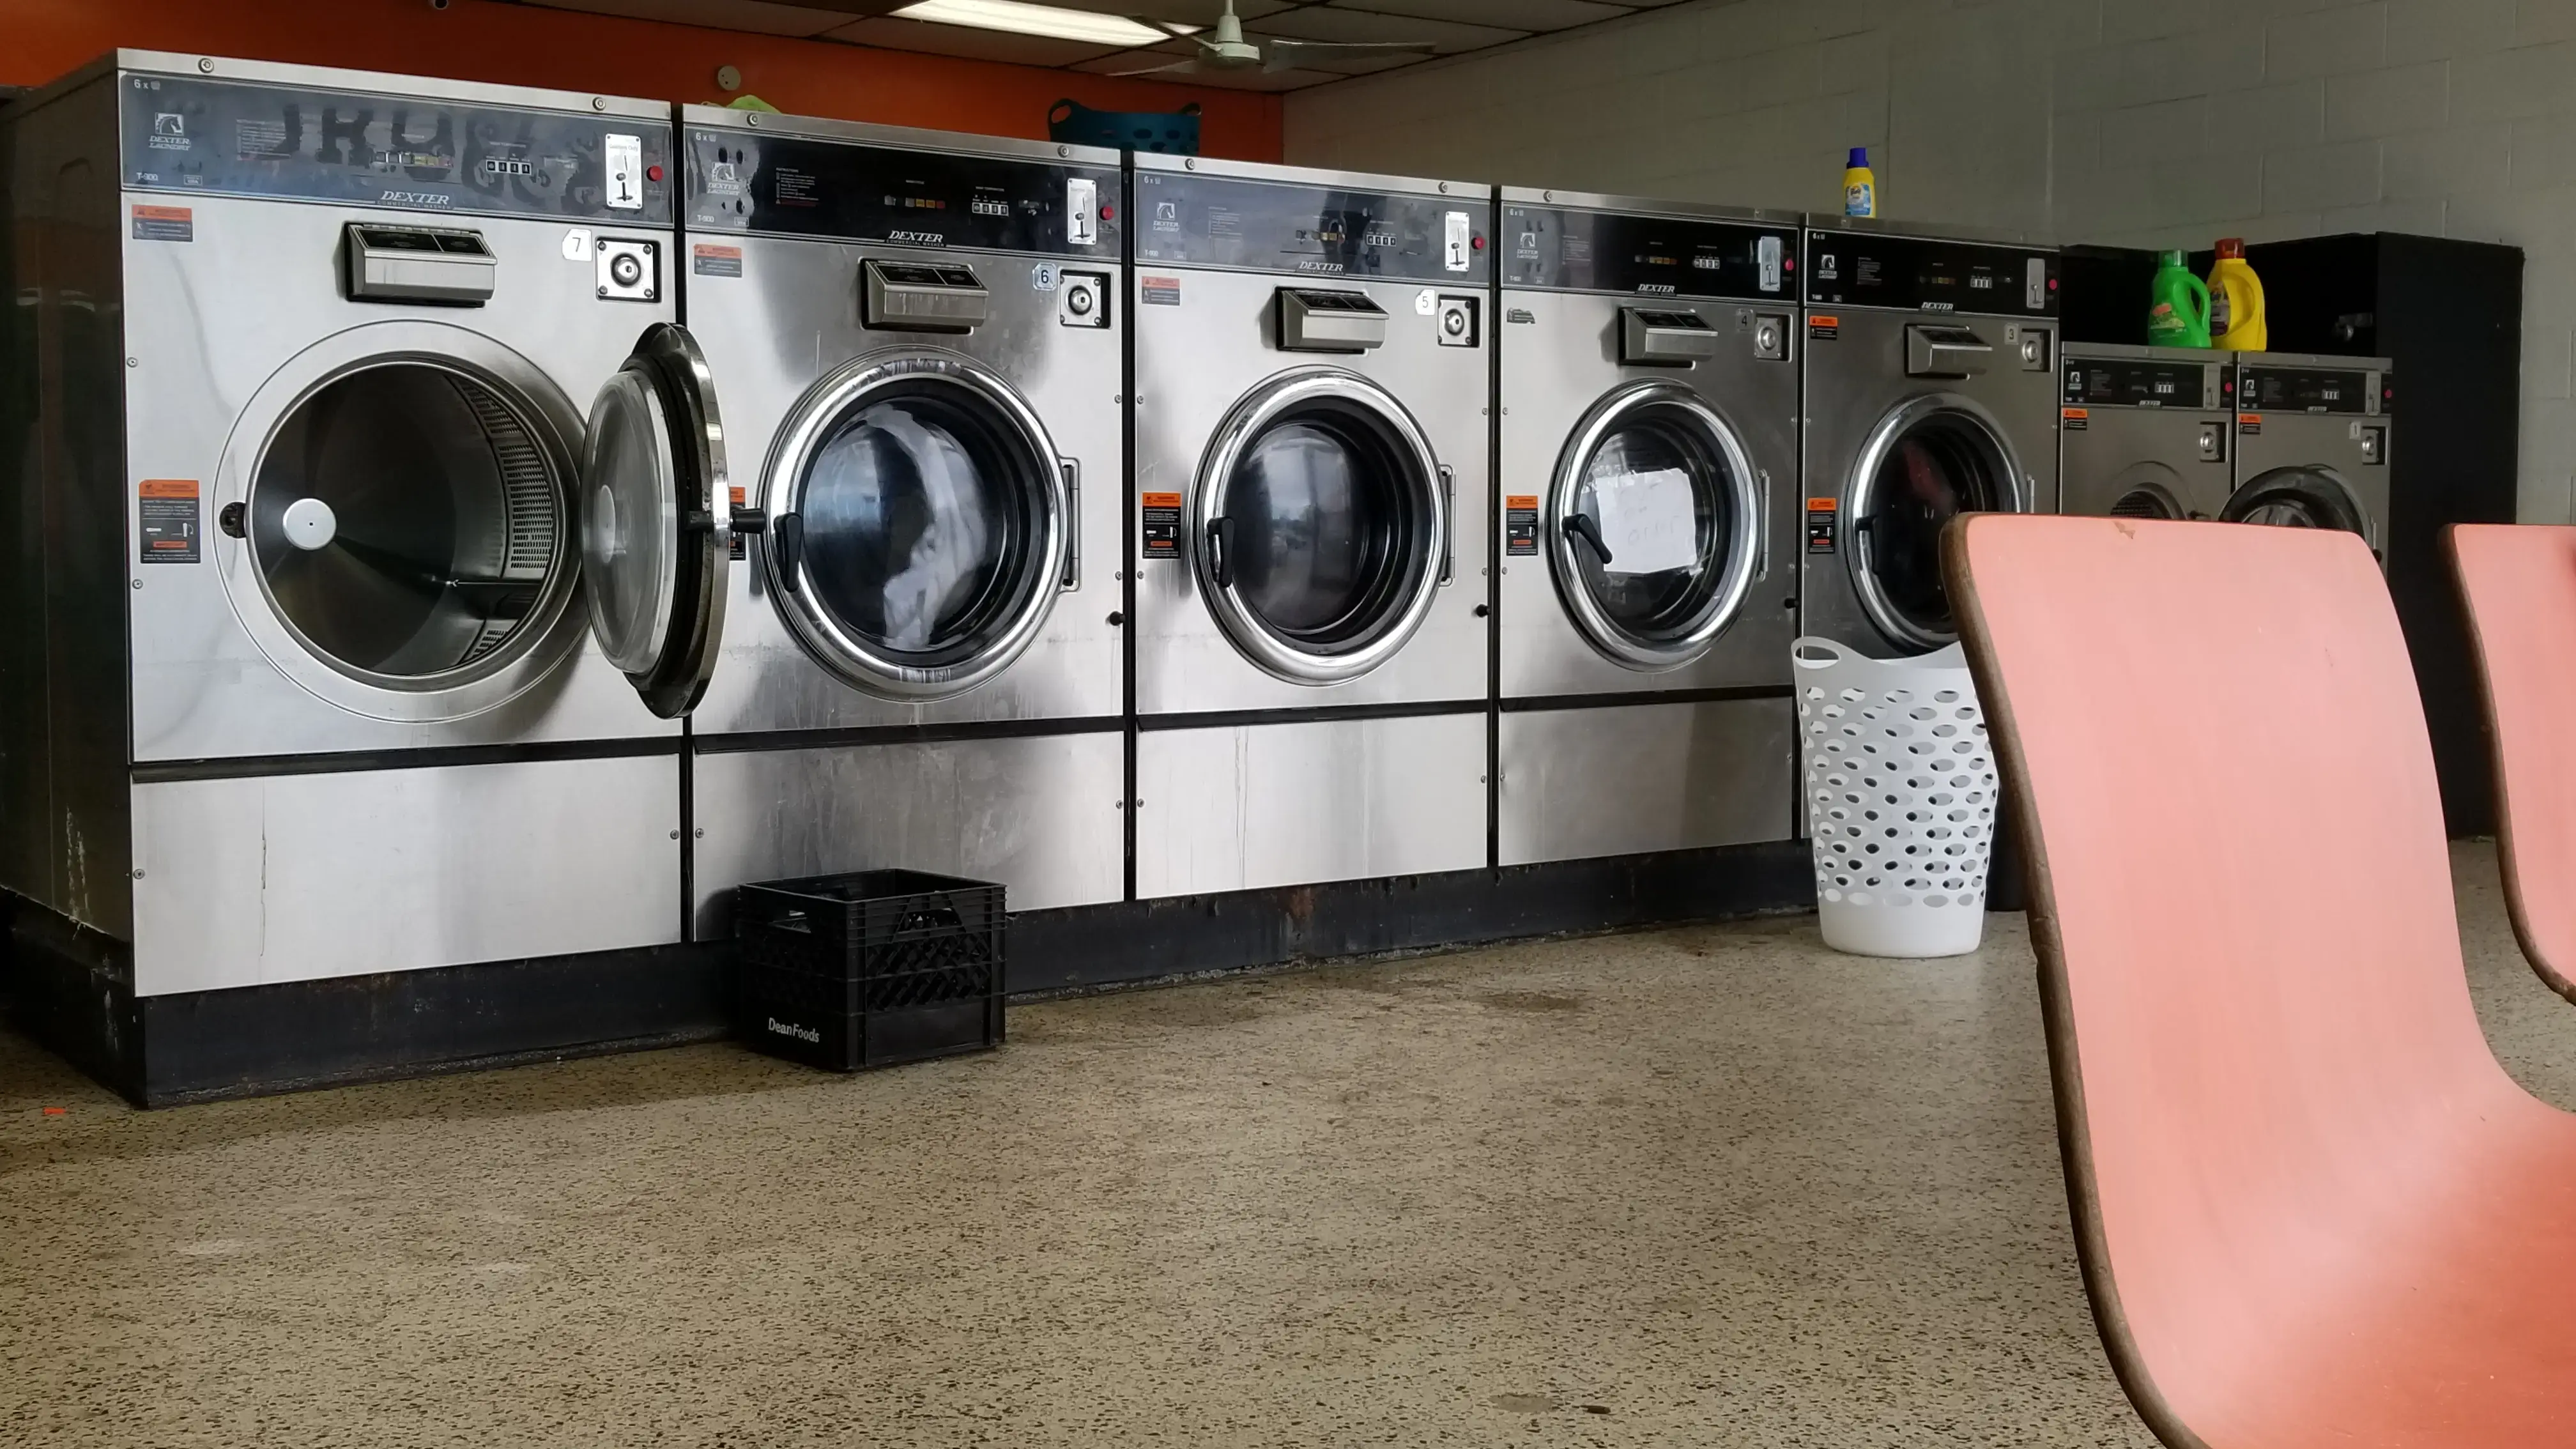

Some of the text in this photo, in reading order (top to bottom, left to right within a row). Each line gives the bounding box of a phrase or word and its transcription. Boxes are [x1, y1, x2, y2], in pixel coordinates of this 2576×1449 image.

[134, 79, 141, 89] 6
[149, 135, 192, 145] DEXTER
[696, 132, 702, 141] 6
[1144, 175, 1149, 184] 6
[380, 190, 450, 204] DEXTER
[888, 230, 943, 243] DEXTER
[571, 237, 583, 252] 7
[1299, 261, 1343, 272] DEXTER
[1039, 269, 1049, 284] 6
[1637, 284, 1675, 293] DEXTER
[1421, 296, 1429, 309] 5
[1921, 302, 1954, 310] DEXTER
[1742, 315, 1749, 327] 4
[2009, 329, 2015, 341] 3
